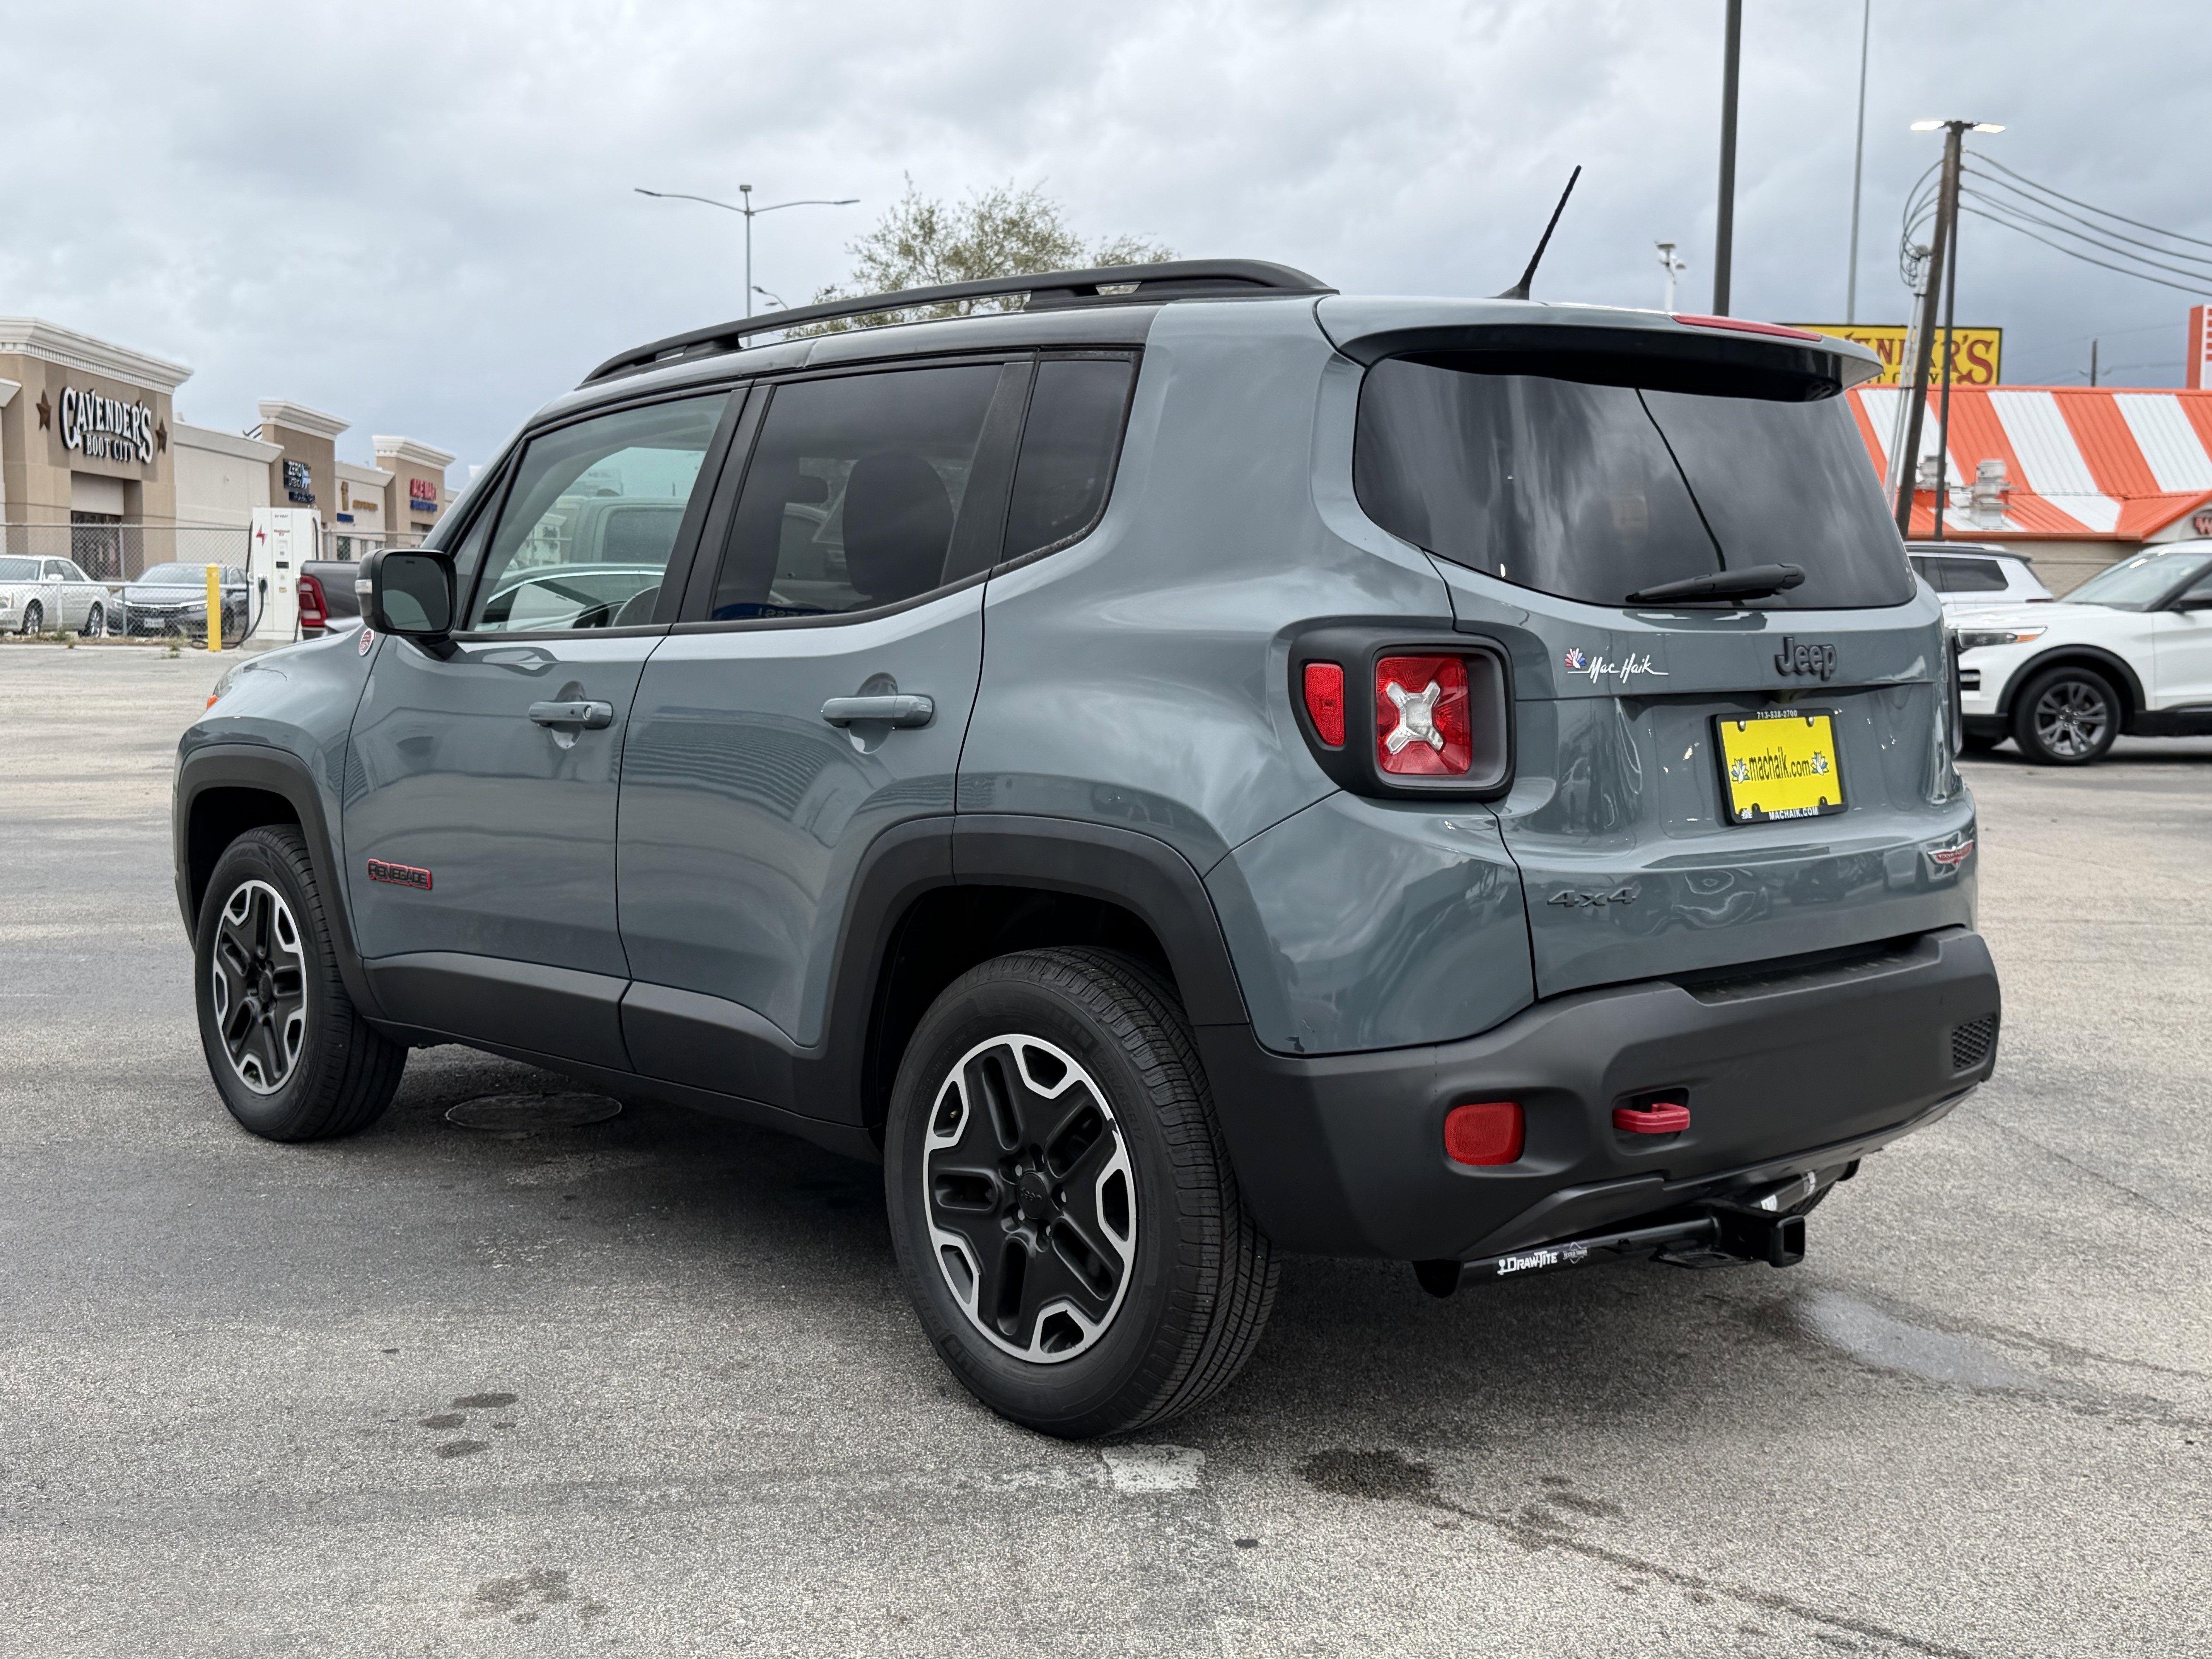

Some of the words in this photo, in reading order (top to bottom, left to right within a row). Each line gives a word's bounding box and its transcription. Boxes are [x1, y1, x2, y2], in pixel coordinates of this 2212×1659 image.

[61, 386, 153, 464] CAVENDER'S
[85, 433, 110, 459] BOOT
[112, 440, 134, 462] CITY
[1576, 656, 1620, 684] Mac
[1620, 653, 1666, 684] Haik
[1775, 637, 1837, 681] Jeep
[1749, 746, 1811, 781] machaik.com
[1769, 807, 1819, 821] MACHAIK.COM
[368, 860, 429, 888] RENEGADE
[1547, 887, 1637, 907] 4x4
